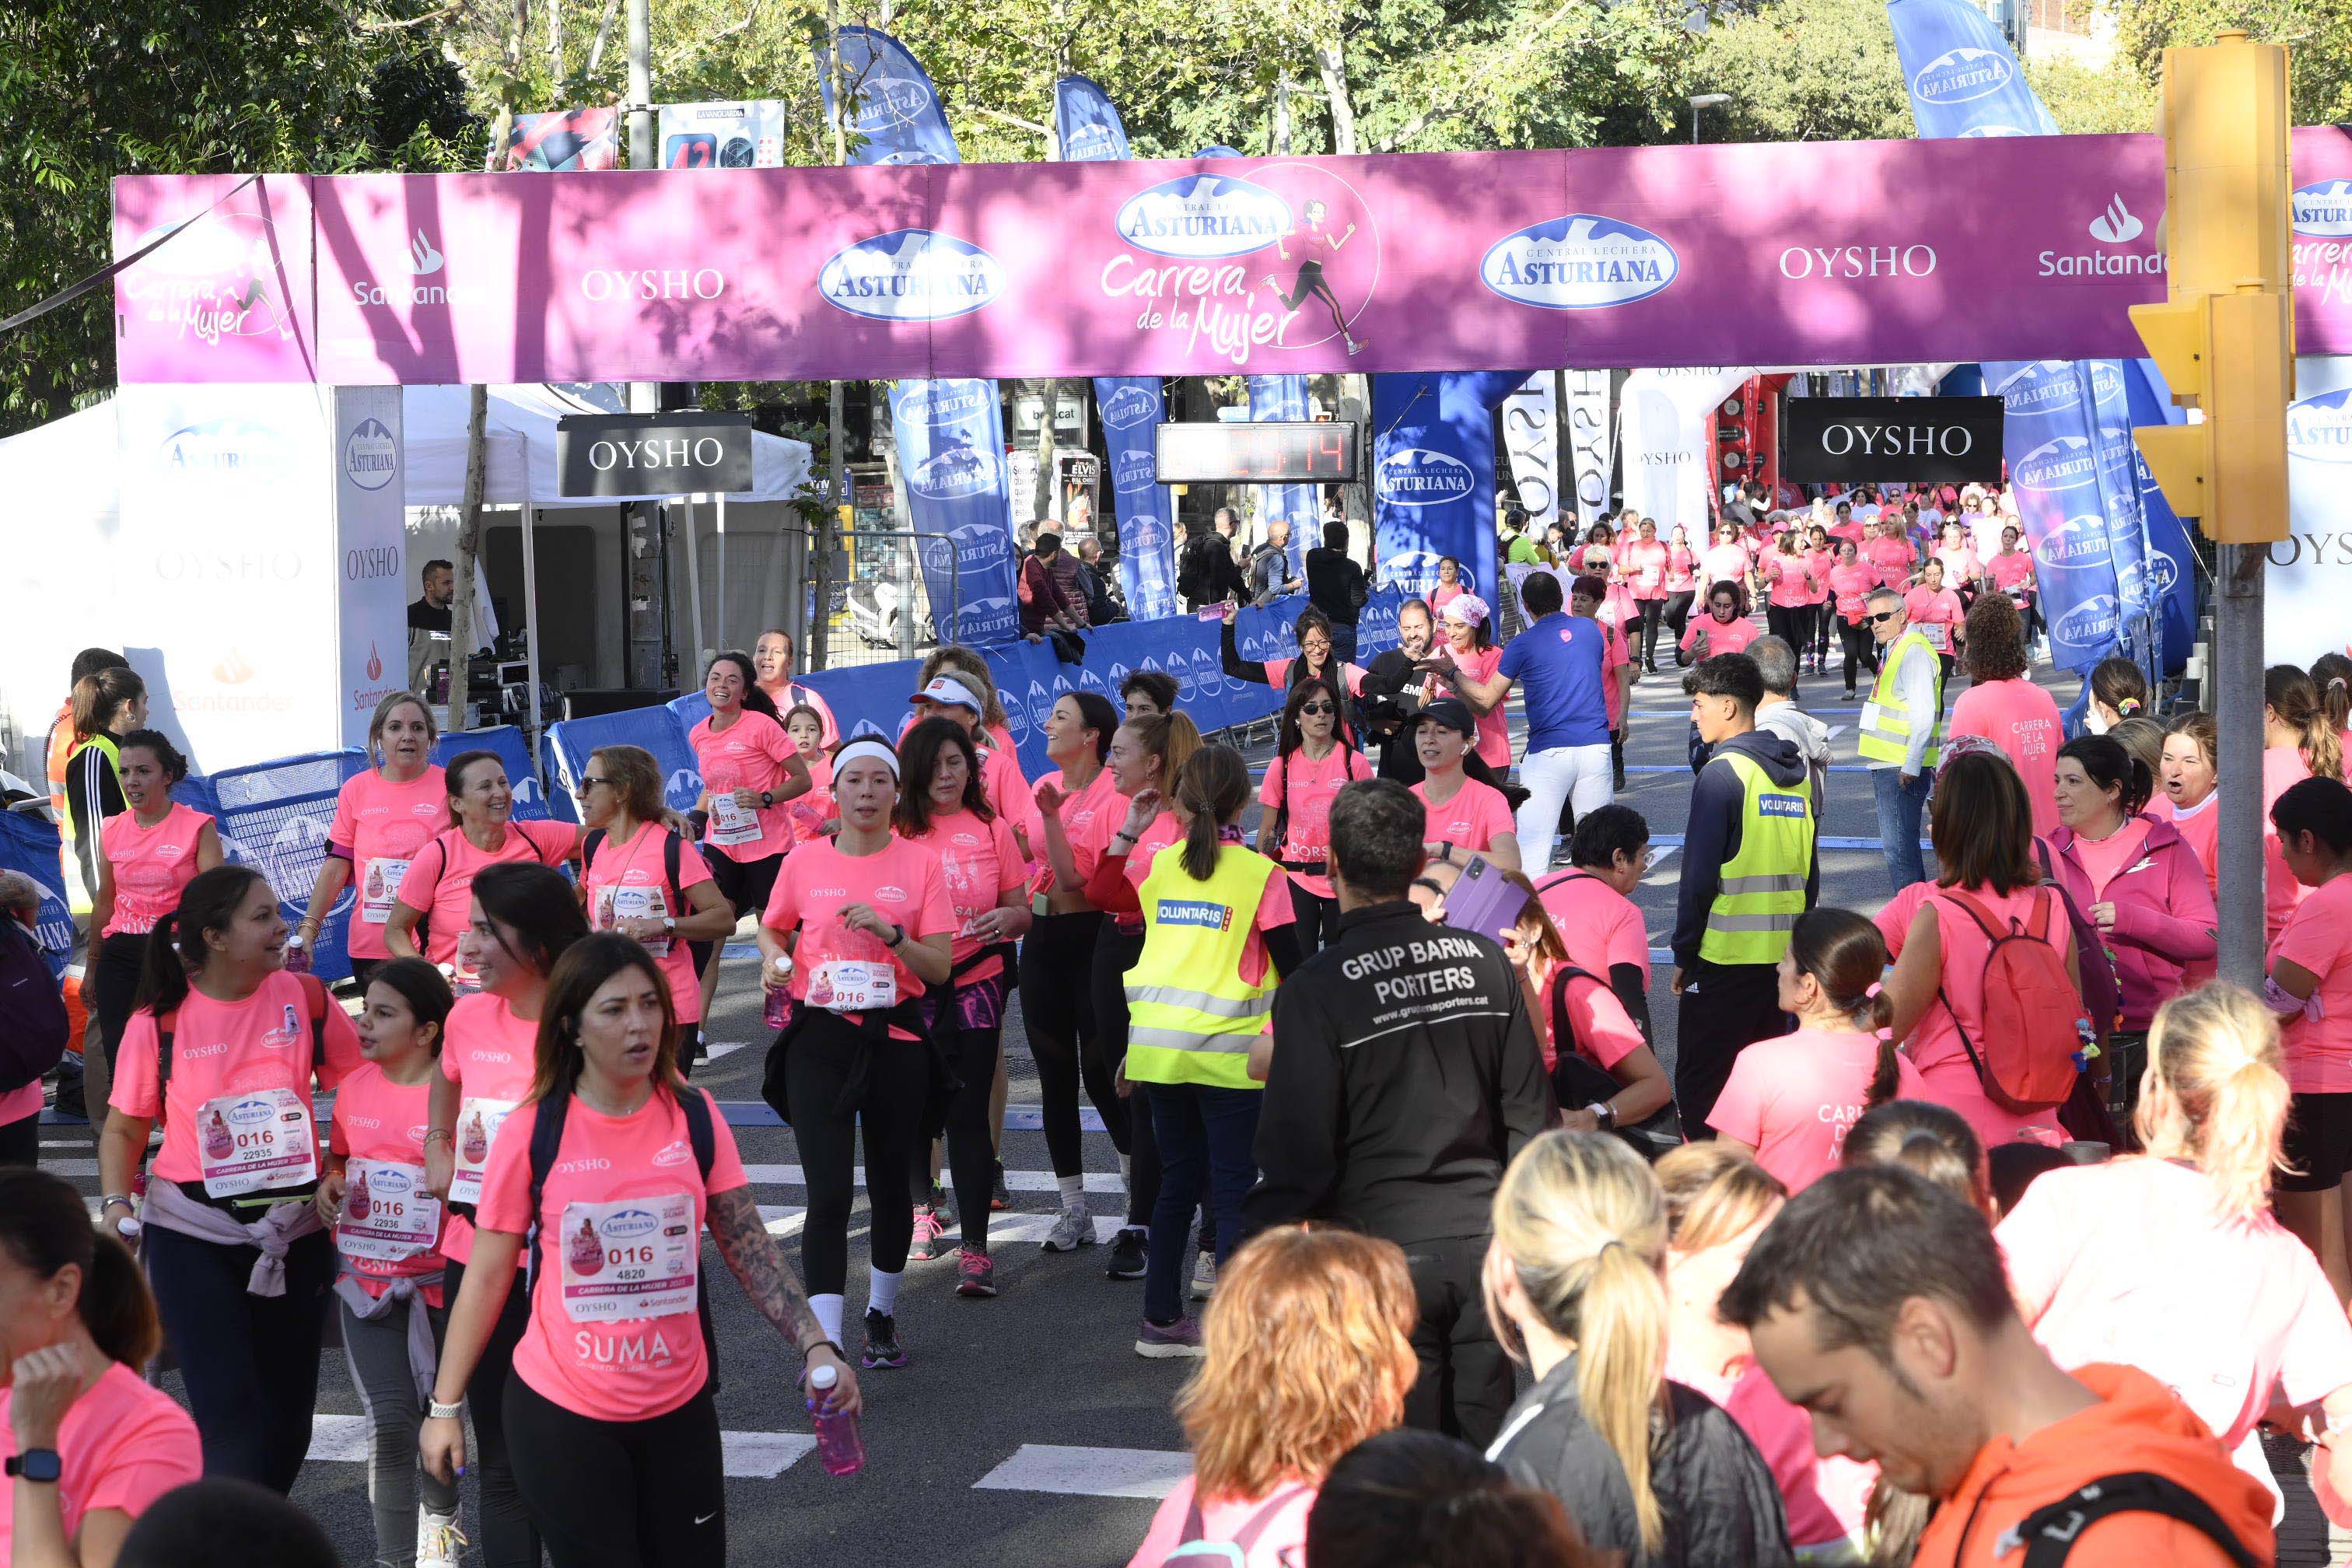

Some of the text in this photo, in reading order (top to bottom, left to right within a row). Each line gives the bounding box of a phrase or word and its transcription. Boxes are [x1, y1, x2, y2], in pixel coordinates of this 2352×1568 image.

[706, 109, 744, 118] VANGUARDIA
[1129, 205, 1278, 237] ASTURIANA
[1526, 244, 1657, 257] CENTRAL LECHERA
[1496, 251, 1663, 285] ASTURIANA
[1779, 243, 1937, 279] OYSHO
[1101, 253, 1246, 298] Carrera
[581, 268, 725, 302] OYSHO
[178, 298, 251, 346] Mujer
[1136, 292, 1300, 365] de la Mujer
[1822, 424, 1972, 457] OYSHO
[348, 444, 394, 474] ASTURIANA
[589, 437, 723, 471] OYSHO
[1072, 464, 1096, 475] ELVIS
[1379, 471, 1467, 494] ASTURIANA
[347, 546, 398, 581] OYSHO
[2011, 718, 2052, 734] CARRERA
[2021, 731, 2044, 744] DE LA
[2022, 743, 2047, 756] MUJER
[720, 813, 737, 821] 016
[452, 877, 472, 887] OYS
[810, 887, 846, 898] OYSHO
[1342, 937, 1484, 981] GRUP BARNA
[1374, 966, 1476, 1005] PORTERS
[836, 992, 865, 1003] 016
[183, 1042, 228, 1060] OYSHO
[471, 1048, 511, 1064] OYSHO
[233, 1108, 273, 1121] ASTURIANA
[348, 1115, 380, 1129] OYSHO
[237, 1129, 275, 1148] 016
[243, 1148, 273, 1160] 22935
[216, 1164, 247, 1175] CARRERA
[267, 1159, 289, 1168] MUJER
[556, 1157, 611, 1174] OYSHO
[215, 1170, 308, 1191] OYSHO Santander
[372, 1177, 408, 1189] ASTURIANA
[373, 1199, 404, 1216] 016
[374, 1217, 399, 1230] 22936
[605, 1220, 655, 1234] ASTURIANA
[351, 1227, 374, 1237] CARRERA
[393, 1232, 412, 1241] MUJER
[345, 1240, 376, 1252] OYSHO
[608, 1246, 654, 1265] 016
[617, 1269, 646, 1280] 4820
[578, 1285, 615, 1295] CARRERA
[617, 1284, 628, 1293] DE
[629, 1283, 639, 1292] LA
[641, 1281, 667, 1292] MUJER
[576, 1294, 688, 1313] OYSHO Santander
[575, 1329, 670, 1365] SUMA
